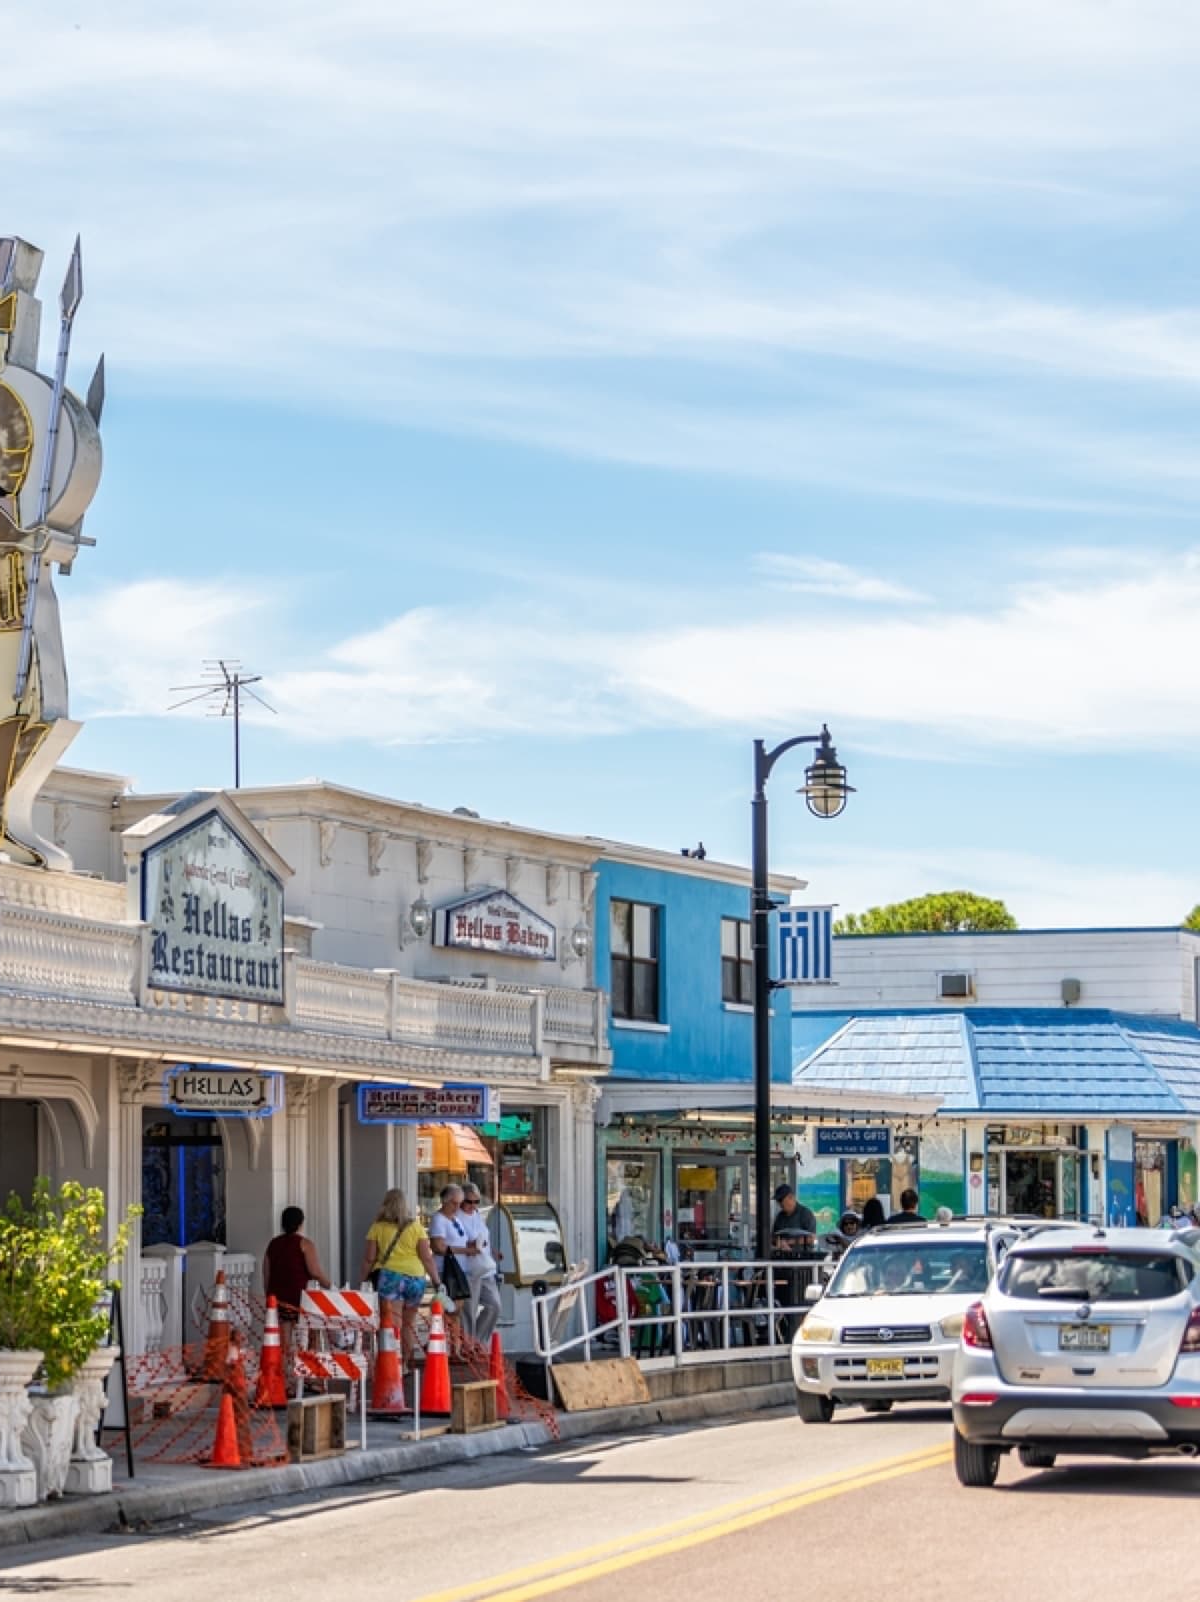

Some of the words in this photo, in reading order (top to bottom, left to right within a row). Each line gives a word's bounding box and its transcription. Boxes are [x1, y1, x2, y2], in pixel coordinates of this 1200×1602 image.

[181, 890, 252, 943] Hellas
[456, 915, 502, 941] Hellas
[507, 921, 549, 954] Bakery
[151, 929, 279, 990] Restaurant
[183, 1076, 253, 1096] HELLAS
[369, 1090, 418, 1102] Hellas
[423, 1089, 481, 1105] Bakery
[439, 1103, 478, 1114] OPEN
[819, 1130, 861, 1142] GLORIA'S
[863, 1130, 887, 1142] GIFTS
